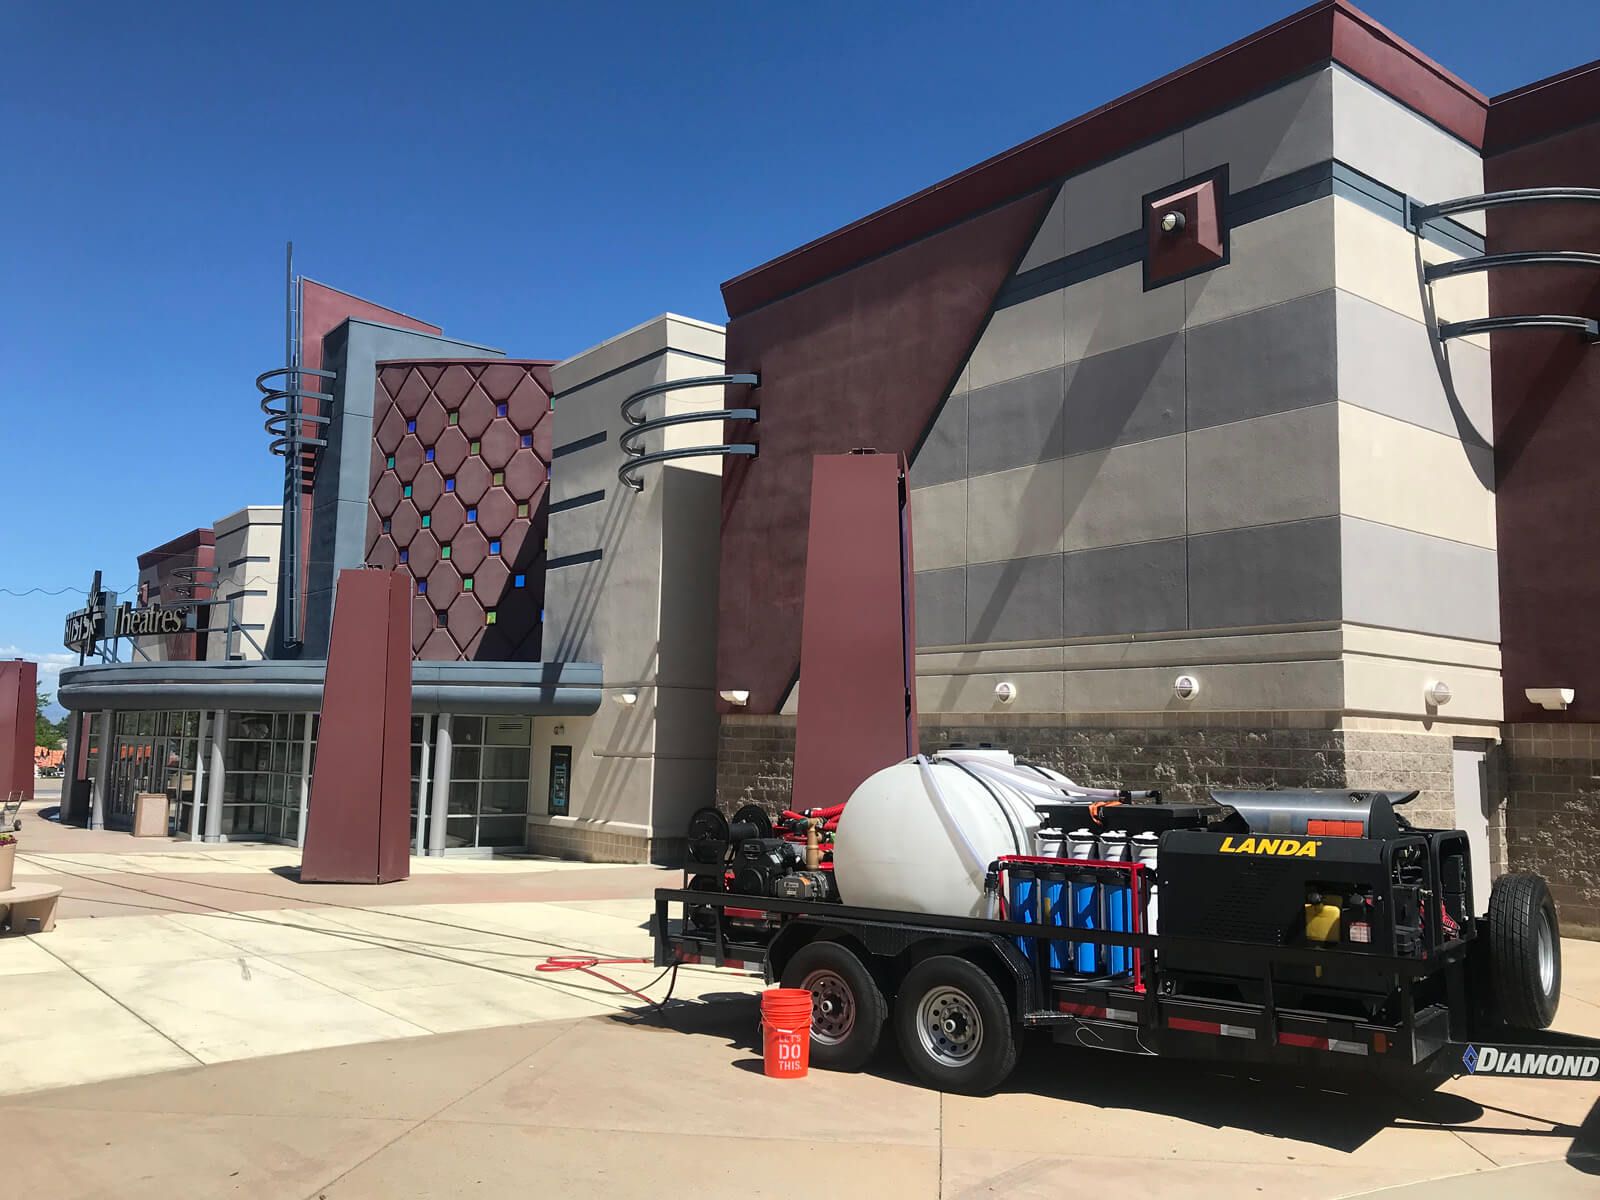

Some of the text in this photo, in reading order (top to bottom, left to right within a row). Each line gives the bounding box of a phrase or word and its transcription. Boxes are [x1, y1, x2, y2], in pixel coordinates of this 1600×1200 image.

[113, 602, 183, 635] Theatres
[1219, 837, 1318, 857] LANDA
[779, 1044, 801, 1060] DO
[1475, 1047, 1600, 1077] DIAMOND
[778, 1061, 802, 1071] THIS.
